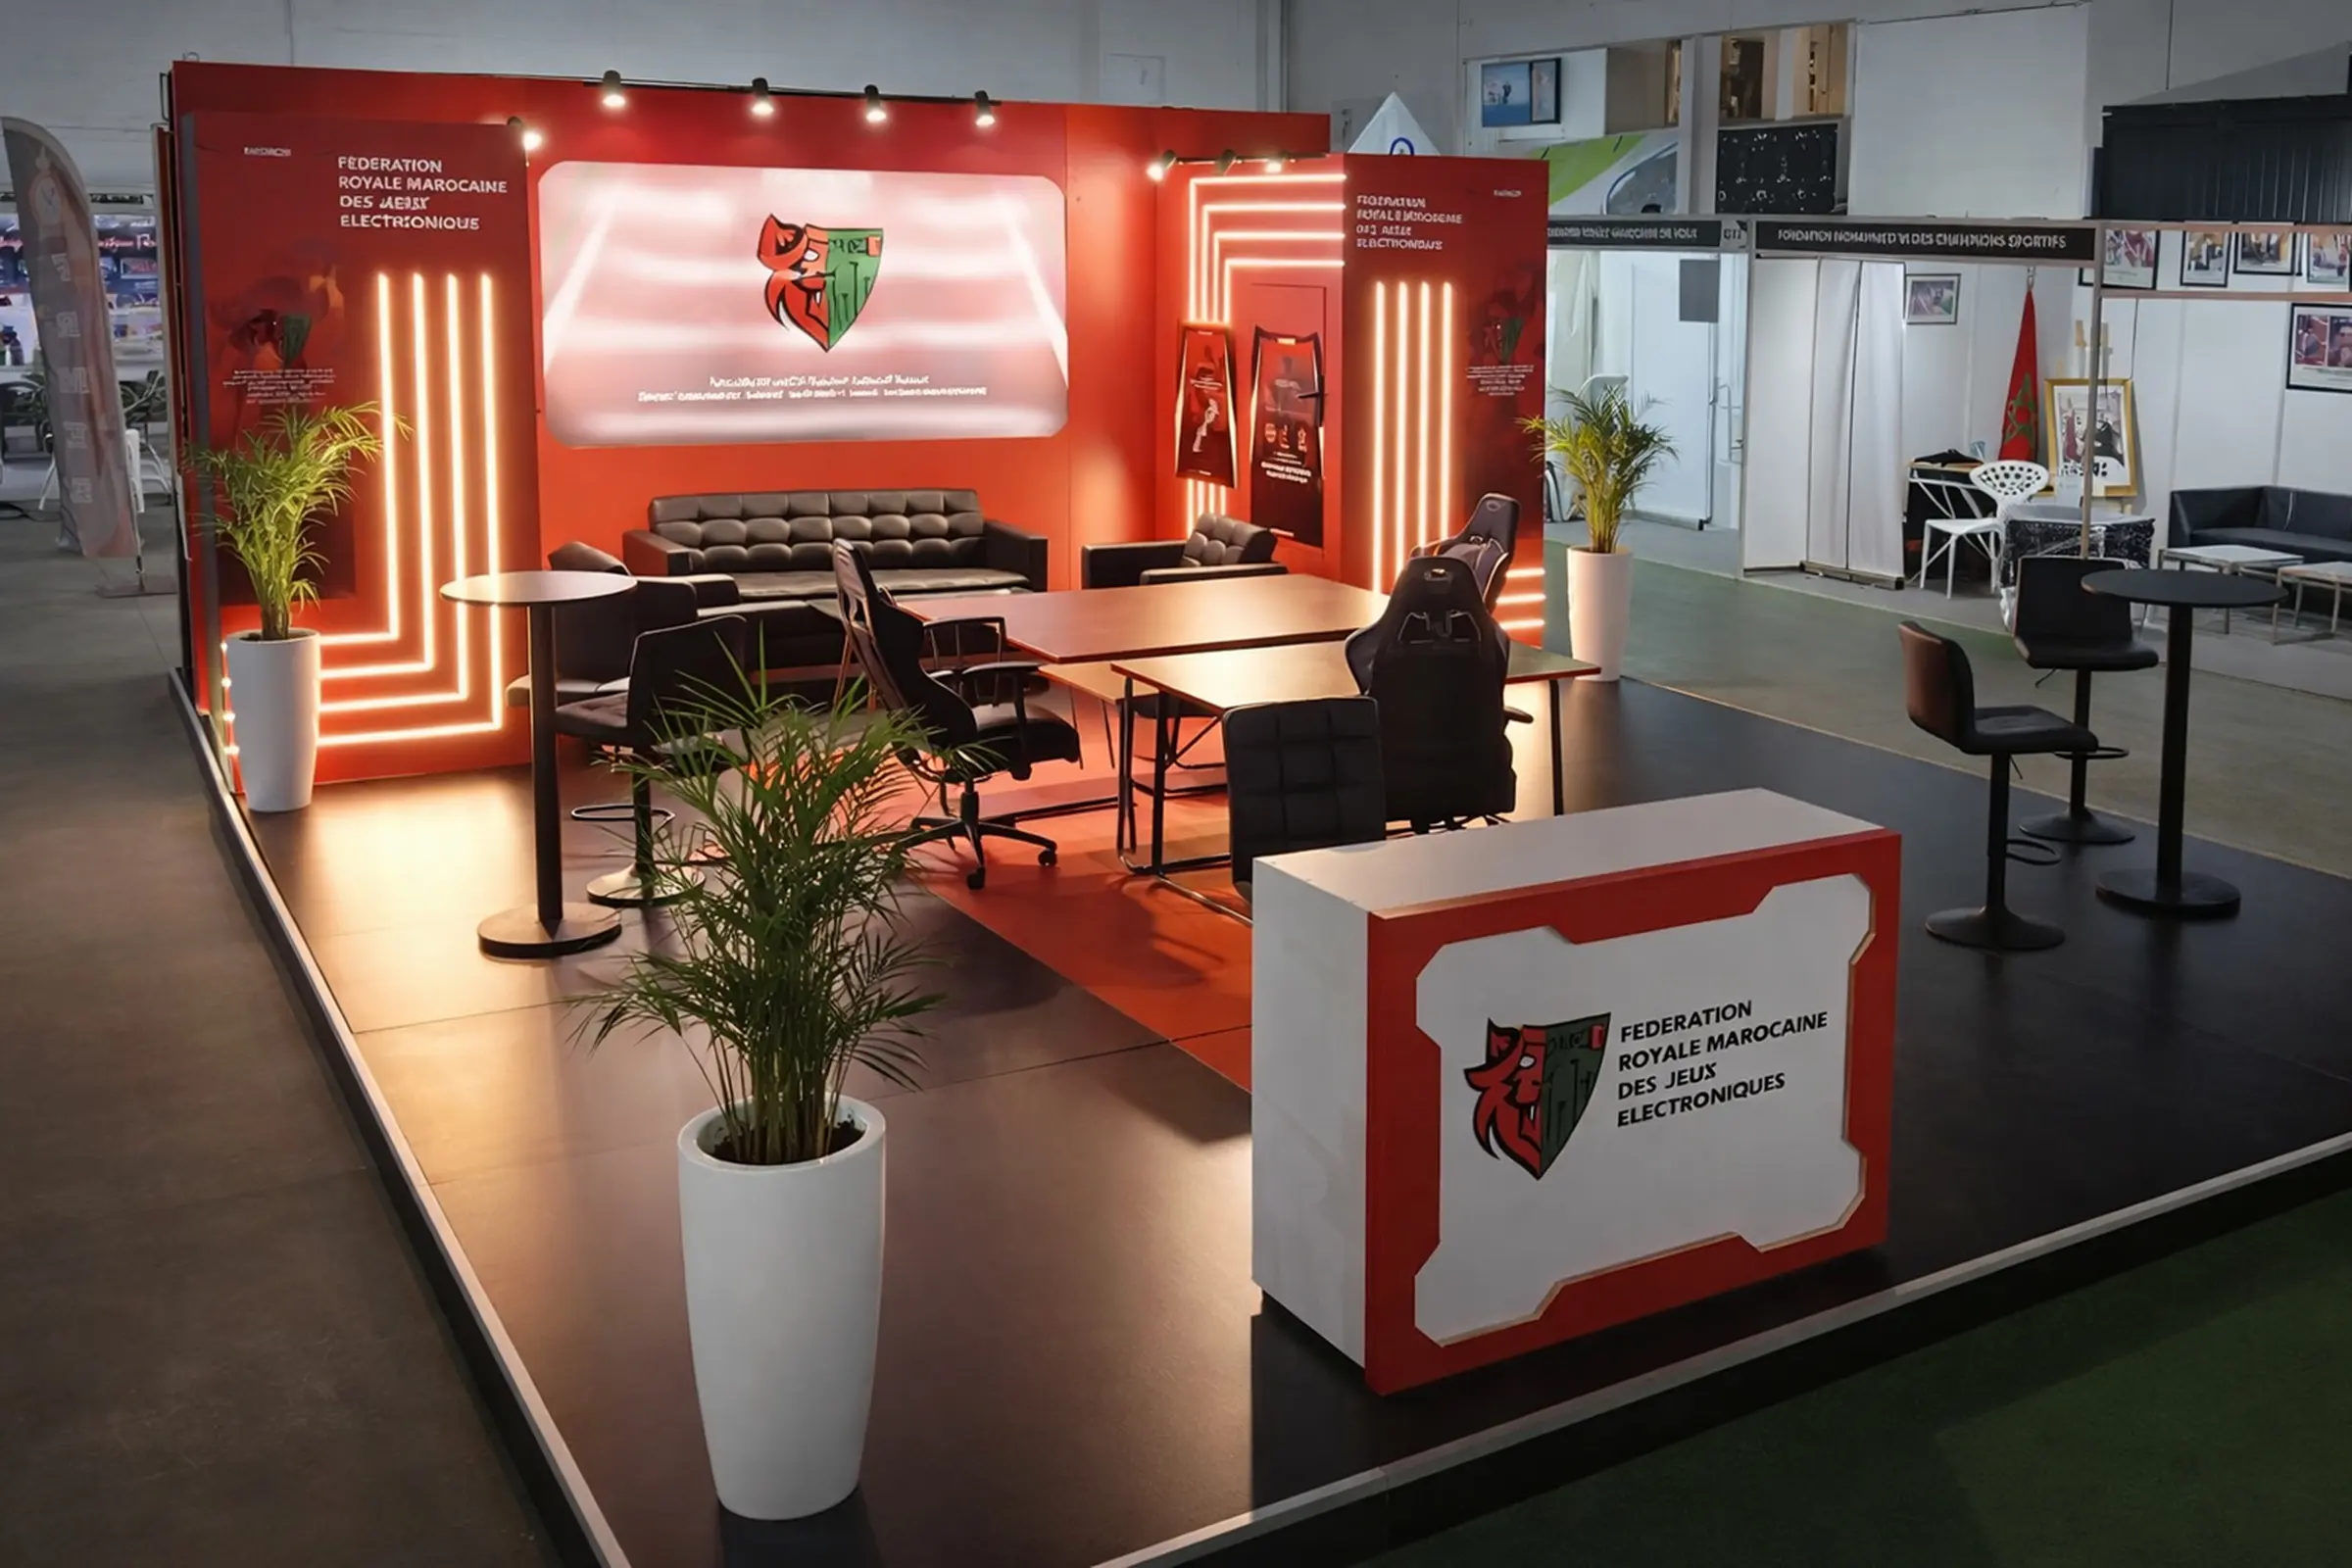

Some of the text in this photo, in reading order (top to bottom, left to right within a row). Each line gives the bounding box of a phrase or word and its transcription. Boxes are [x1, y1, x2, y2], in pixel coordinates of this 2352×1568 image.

[338, 156, 442, 173] FEDERATION
[338, 176, 508, 193] ROYALE MAROCAINE
[340, 196, 373, 209] DES
[1621, 1000, 1752, 1043] FEDERATION
[1619, 1039, 1701, 1071] ROYALE
[1706, 1011, 1828, 1053] MAROCAINE
[1617, 1072, 1786, 1128] ELECTRONIQUES
[1618, 1062, 1717, 1100] DES JEUX
